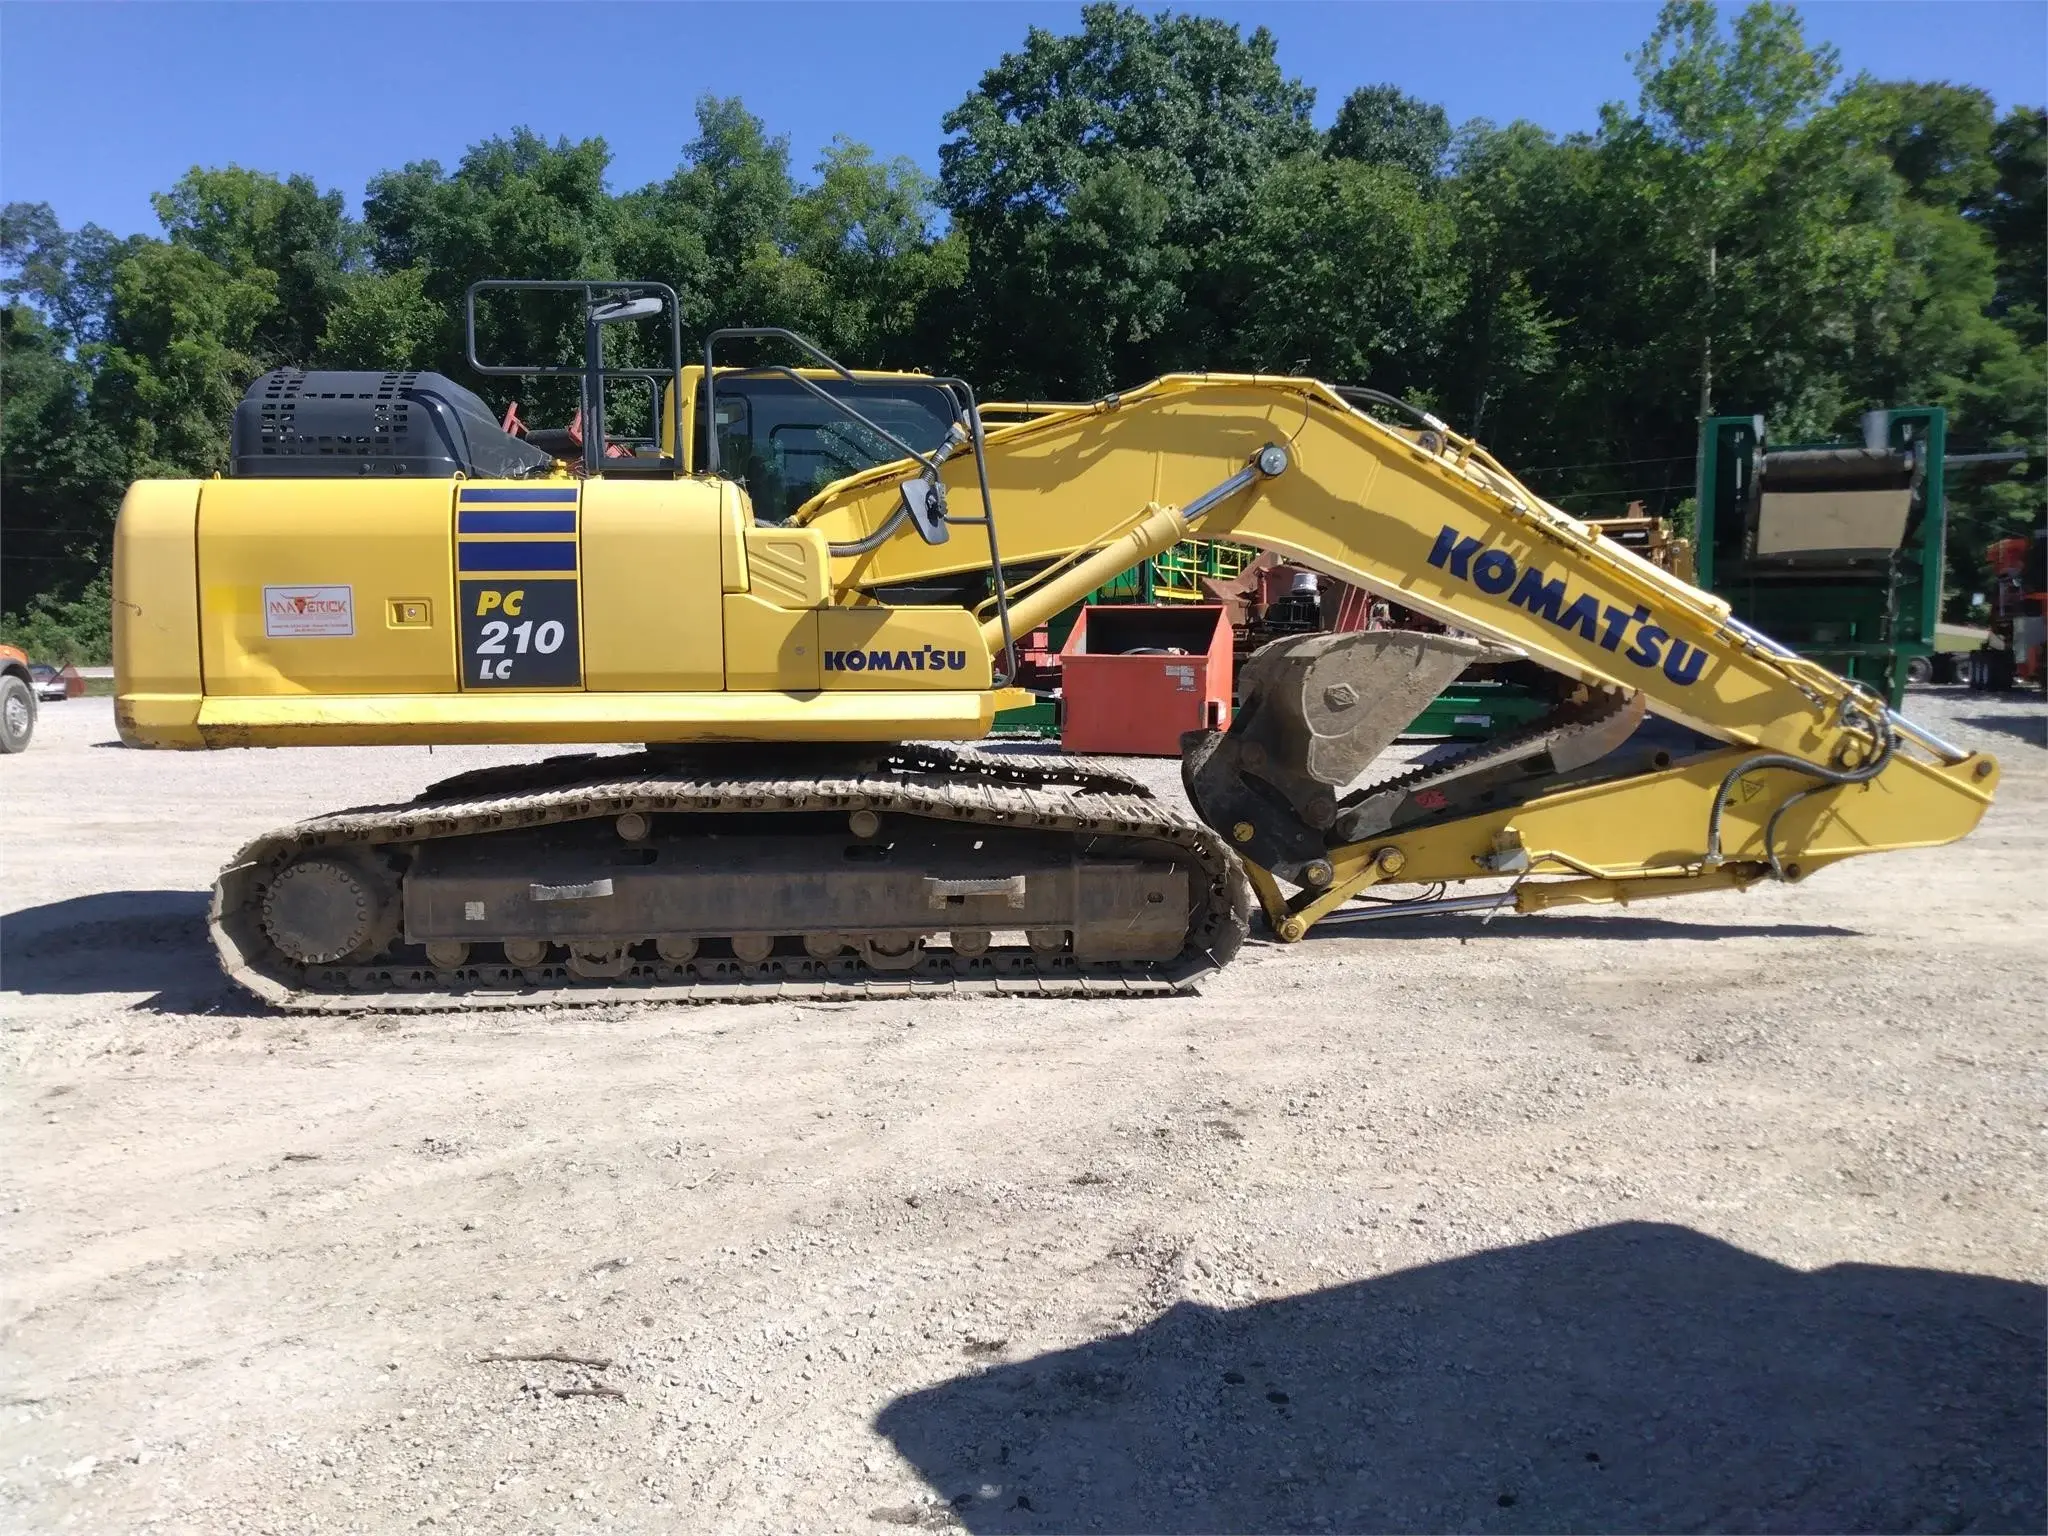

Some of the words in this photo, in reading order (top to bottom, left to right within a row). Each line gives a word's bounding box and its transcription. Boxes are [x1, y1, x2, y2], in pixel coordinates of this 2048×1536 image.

[476, 590, 525, 616] PC
[1427, 525, 1708, 686] KOMATSU
[476, 620, 565, 654] 210
[479, 659, 513, 680] LC
[824, 645, 966, 671] KOMATSU
